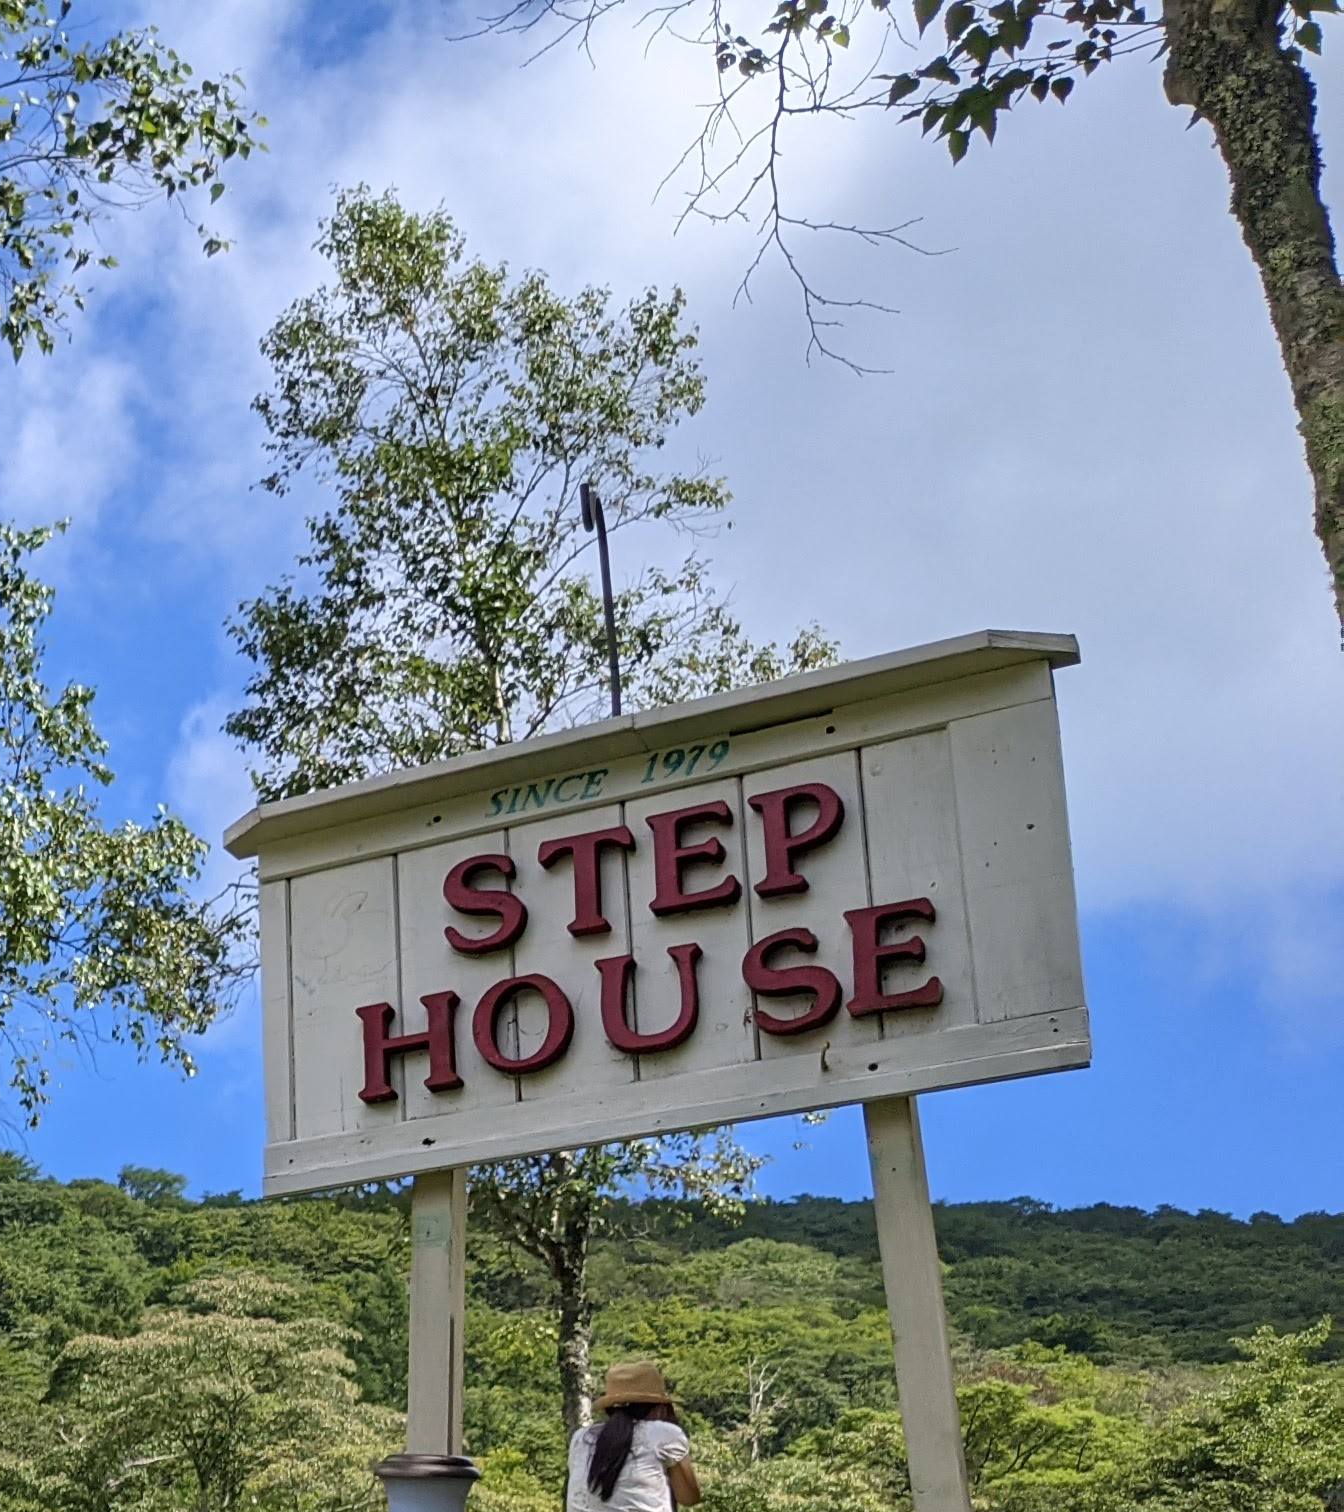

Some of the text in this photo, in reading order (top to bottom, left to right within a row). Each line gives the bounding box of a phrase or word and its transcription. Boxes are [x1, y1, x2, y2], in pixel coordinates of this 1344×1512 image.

[485, 740, 730, 819] SINCE 1979
[443, 782, 845, 956] STEP
[356, 897, 944, 1105] HOUSE
